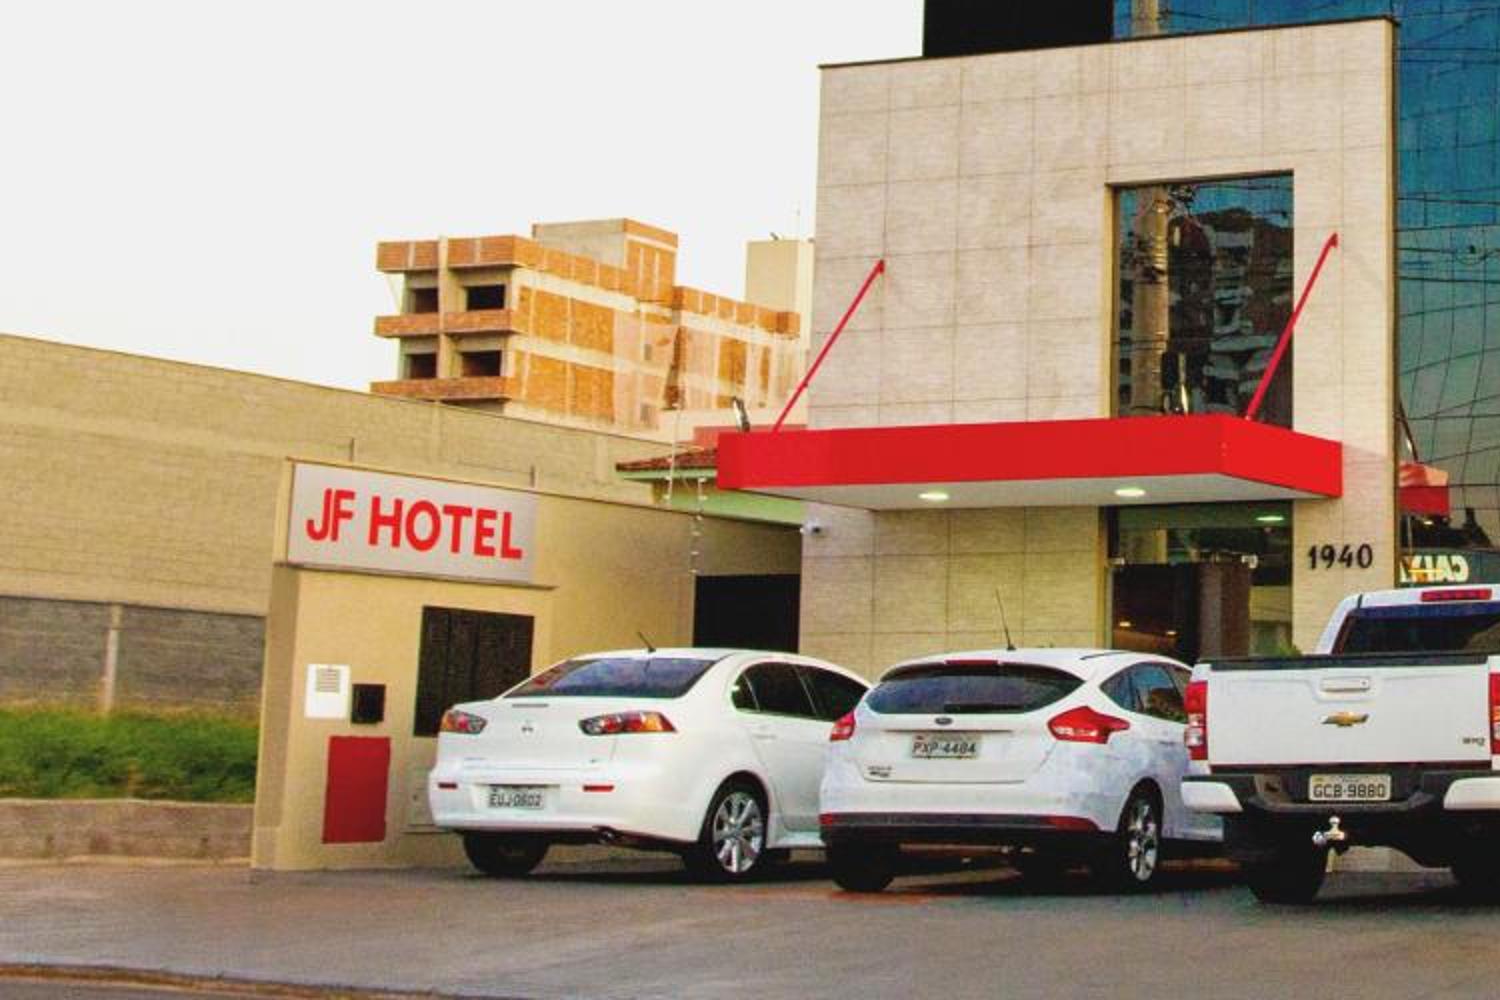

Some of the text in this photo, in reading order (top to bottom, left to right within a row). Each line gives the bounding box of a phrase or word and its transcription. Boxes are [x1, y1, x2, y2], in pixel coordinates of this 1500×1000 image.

[306, 488, 523, 560] JF HOTEL
[1308, 543, 1373, 570] 1940
[1313, 783, 1386, 798] GCB-9880
